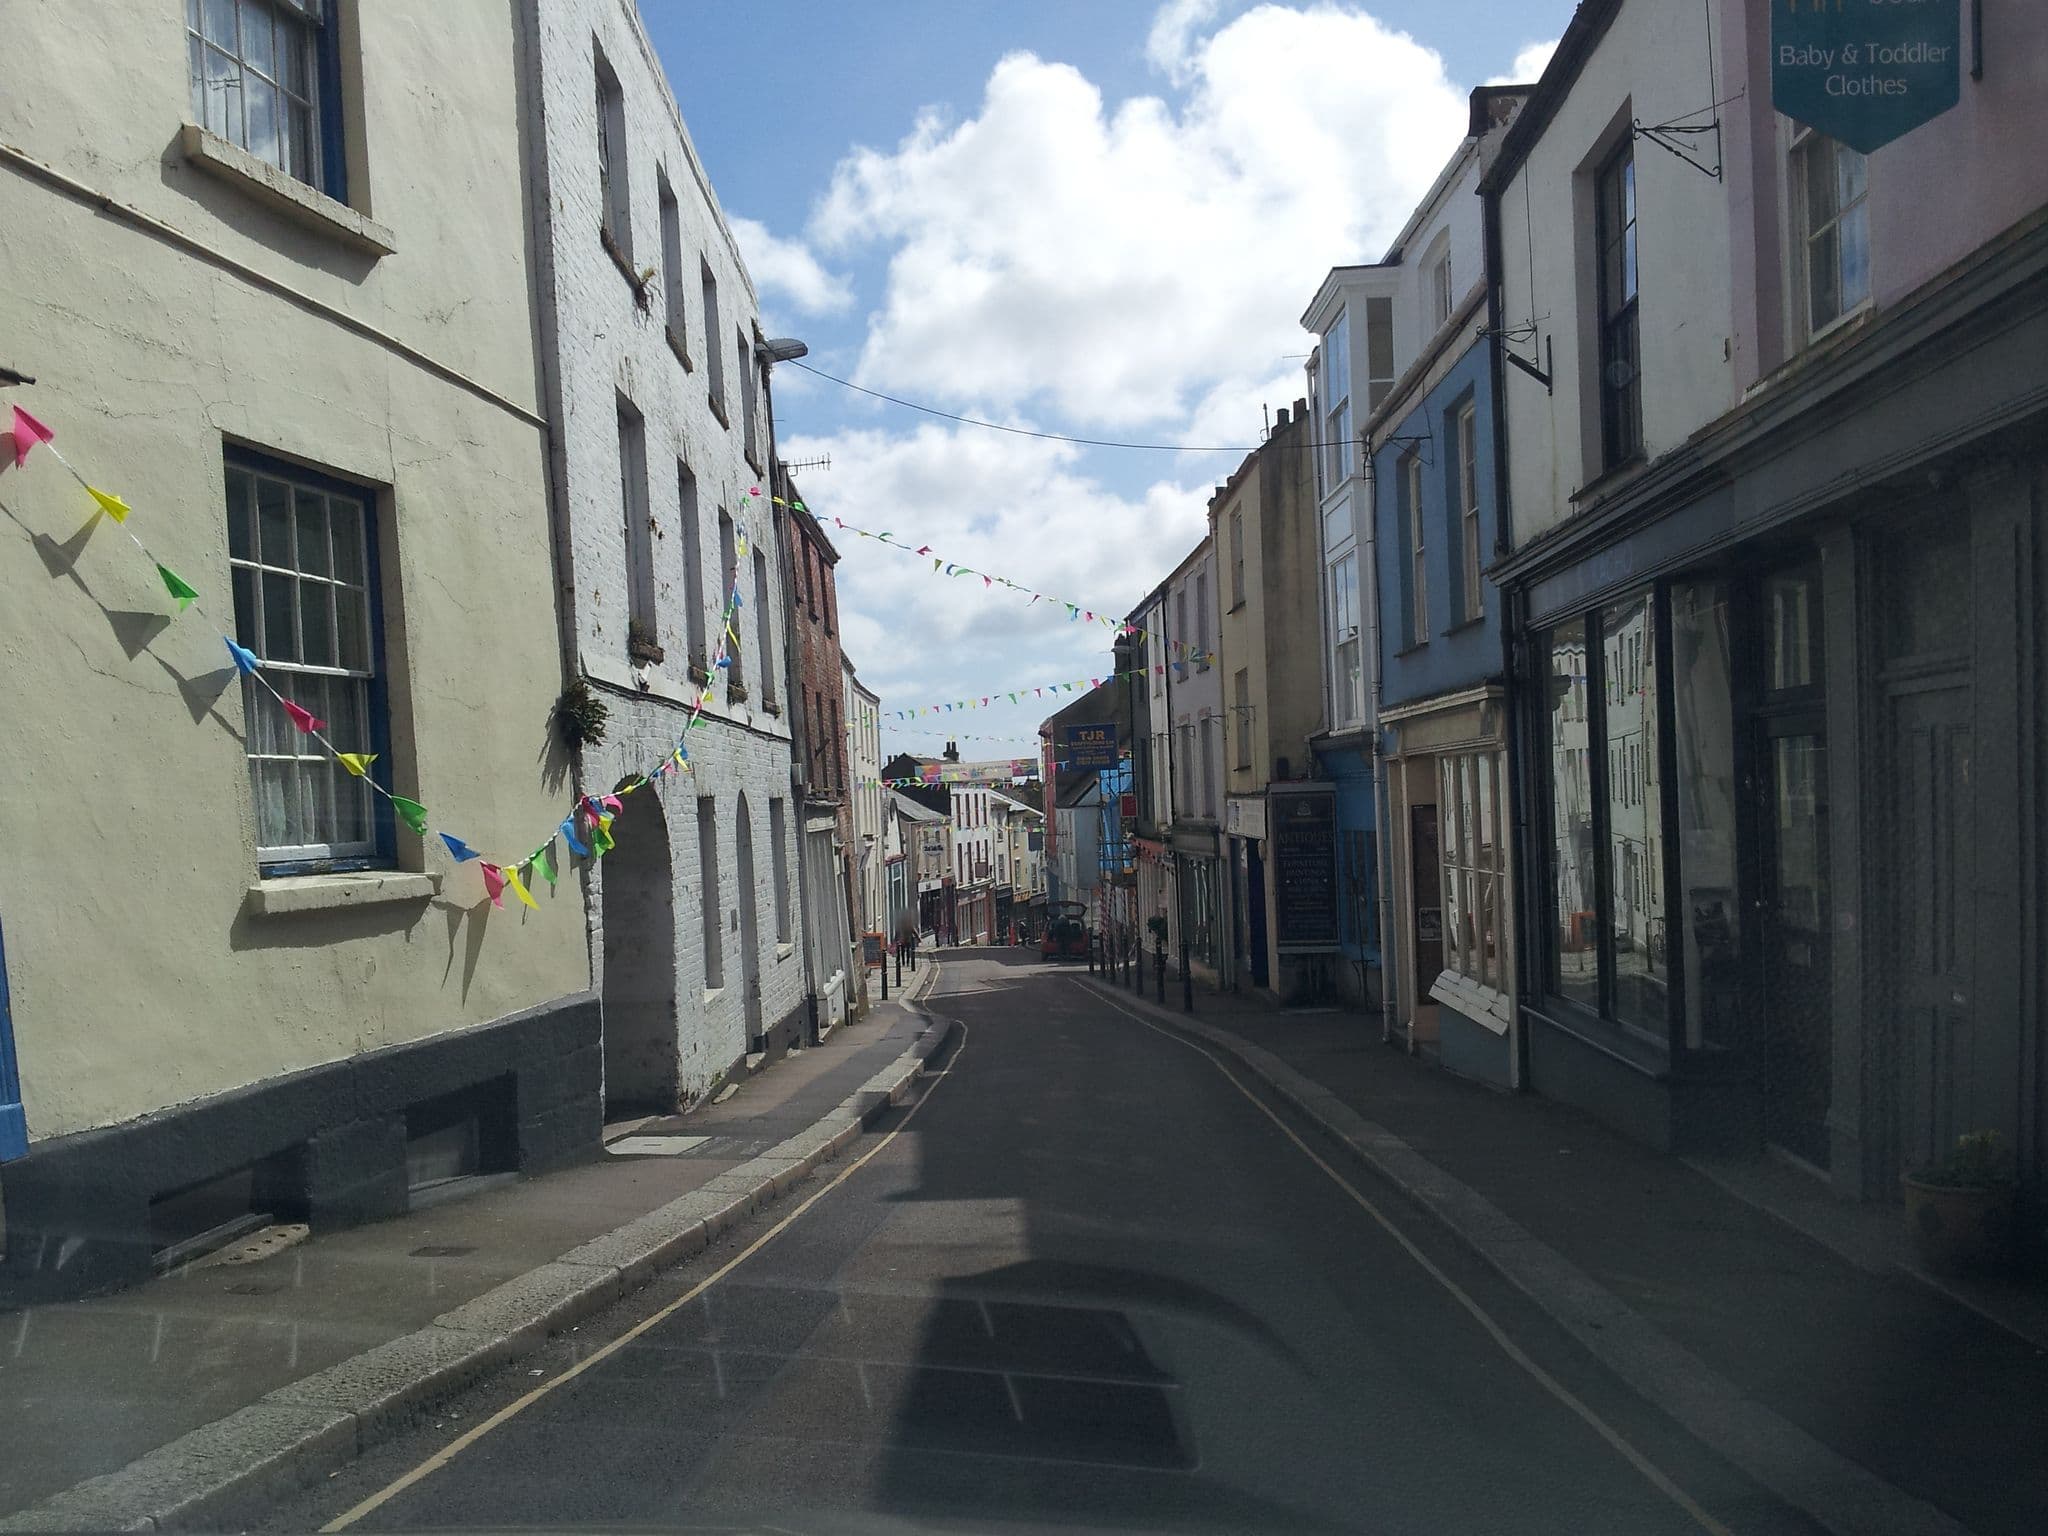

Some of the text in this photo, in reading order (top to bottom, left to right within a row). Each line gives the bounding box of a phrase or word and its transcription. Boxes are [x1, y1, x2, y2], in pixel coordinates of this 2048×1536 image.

[1779, 41, 1950, 70] Baby & Toddler
[1826, 74, 1908, 96] Clothes
[1079, 731, 1105, 740] TJR
